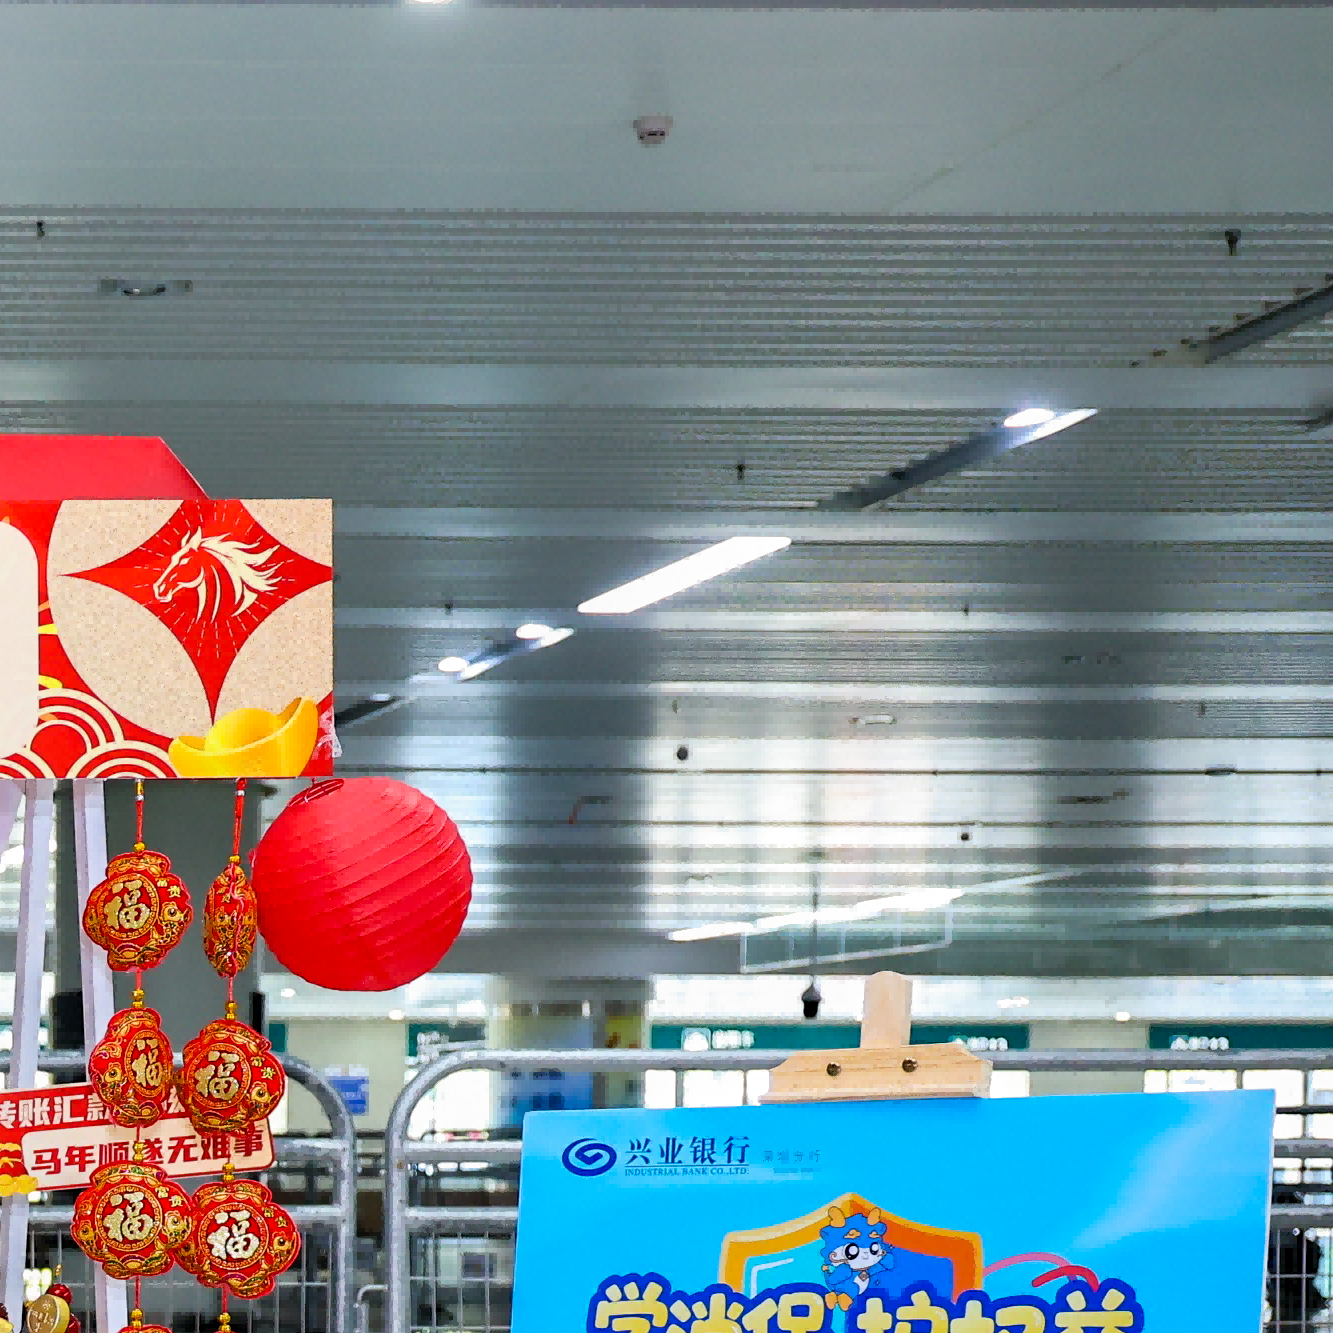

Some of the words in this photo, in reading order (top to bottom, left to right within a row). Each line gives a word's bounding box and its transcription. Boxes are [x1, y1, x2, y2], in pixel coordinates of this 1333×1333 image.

[104, 880, 151, 930] 福
[132, 1039, 164, 1088] 福
[194, 1051, 240, 1101] 福
[624, 1167, 681, 1177] INDUSTRIAL
[682, 1167, 708, 1177] BANK
[625, 1136, 750, 1165] 兴业银行
[103, 1191, 154, 1241] 福
[207, 1210, 260, 1260] 福
